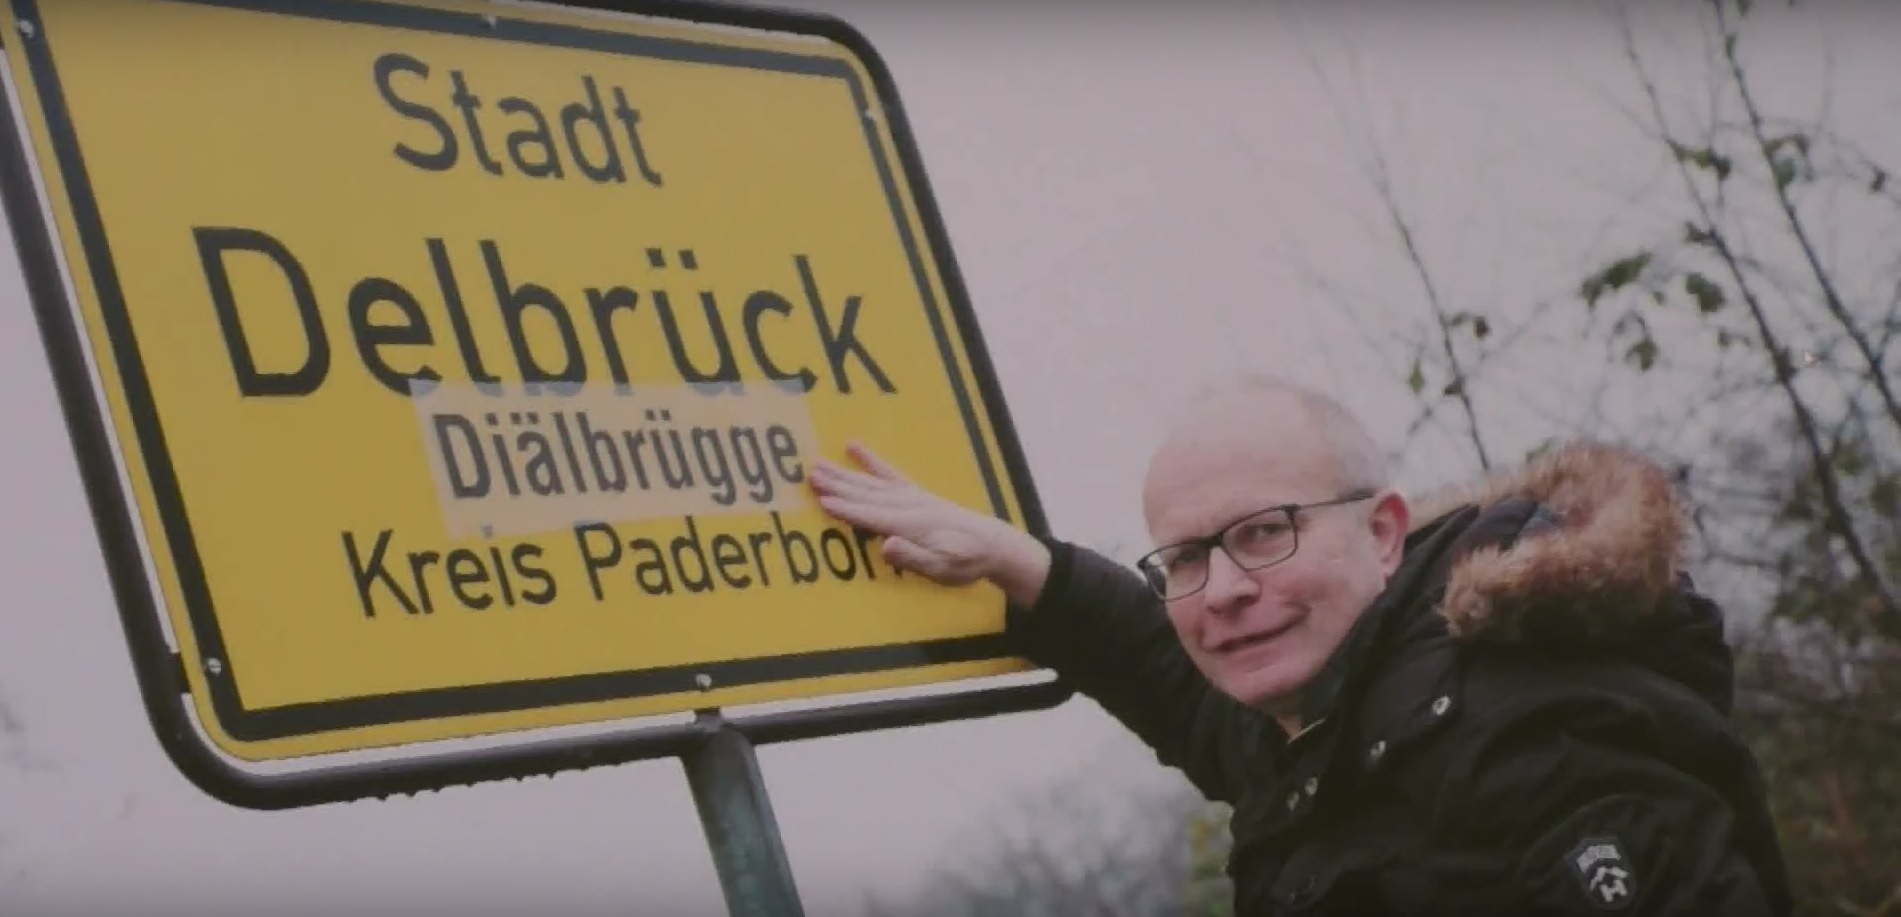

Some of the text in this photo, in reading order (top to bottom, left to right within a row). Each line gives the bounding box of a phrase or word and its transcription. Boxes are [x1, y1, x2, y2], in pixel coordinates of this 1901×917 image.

[373, 53, 664, 187] Stadt
[191, 225, 897, 398] Delbrück
[432, 408, 806, 505] Diälbrügge
[341, 511, 903, 618] Kreis Paderbor
